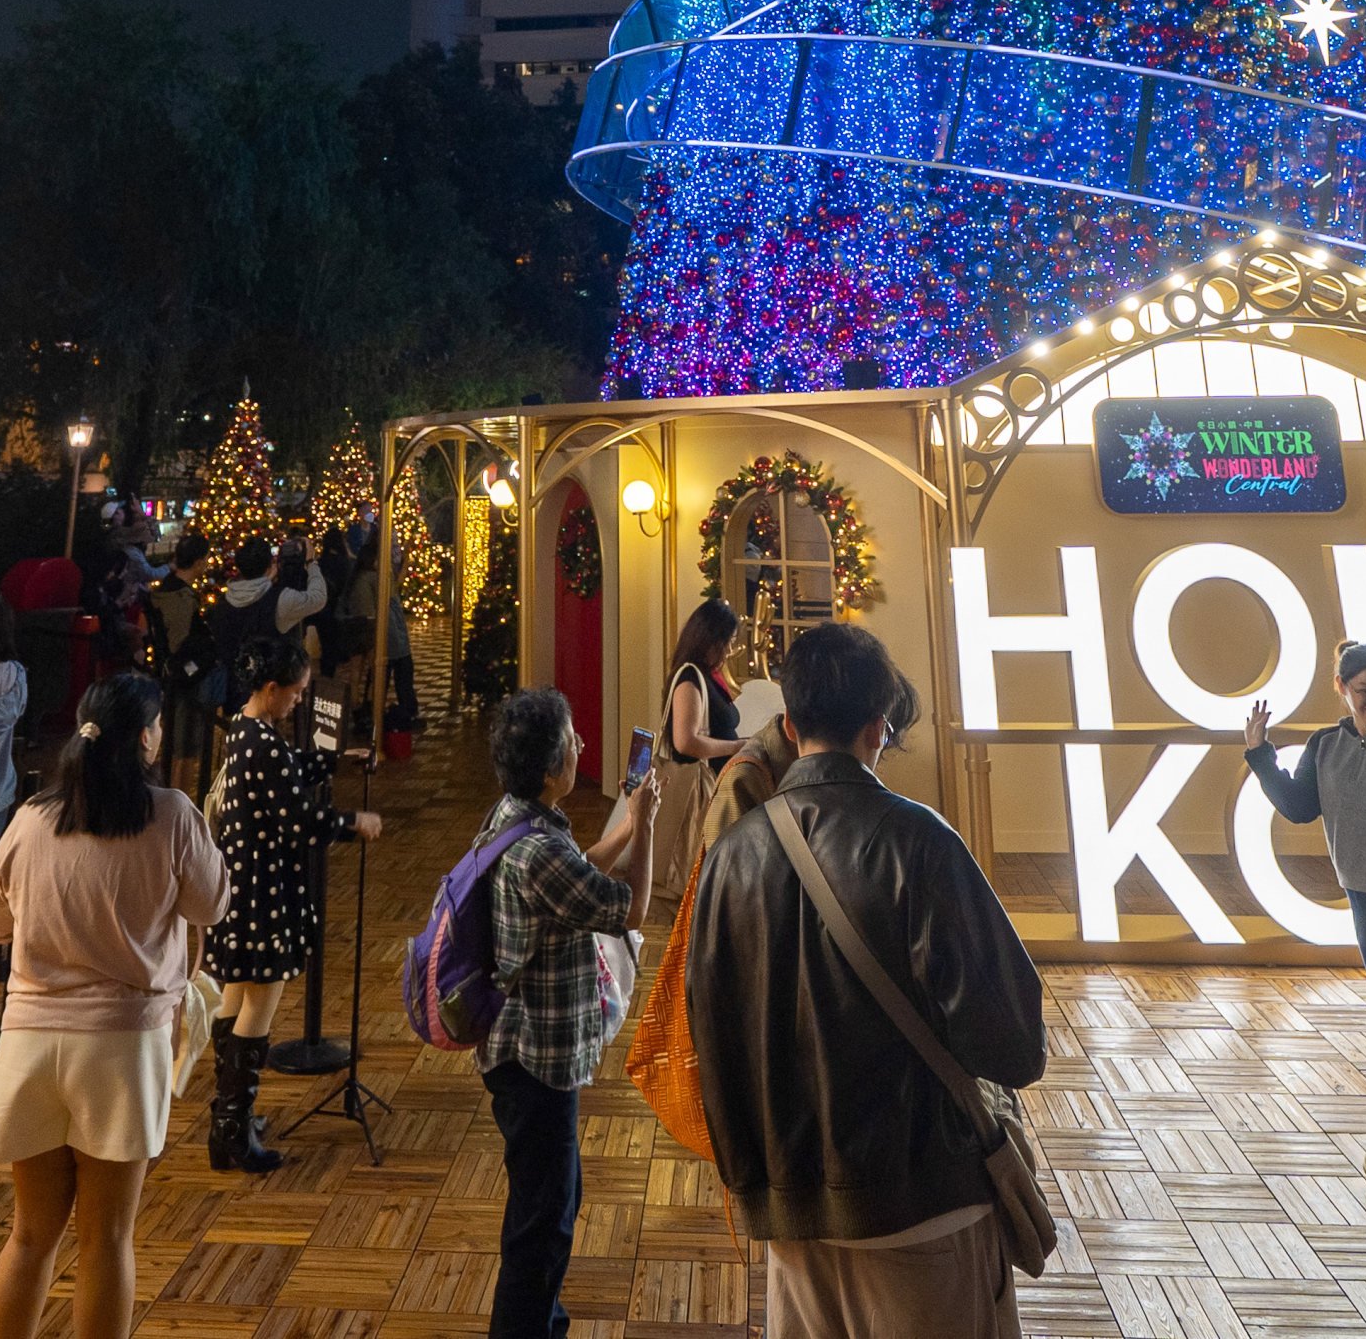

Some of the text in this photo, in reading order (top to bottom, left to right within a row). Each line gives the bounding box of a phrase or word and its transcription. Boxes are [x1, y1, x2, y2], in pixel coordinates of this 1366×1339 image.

[1199, 431, 1314, 456] WINTER
[1202, 458, 1318, 479] WONDERLAND
[1224, 473, 1302, 497] Central
